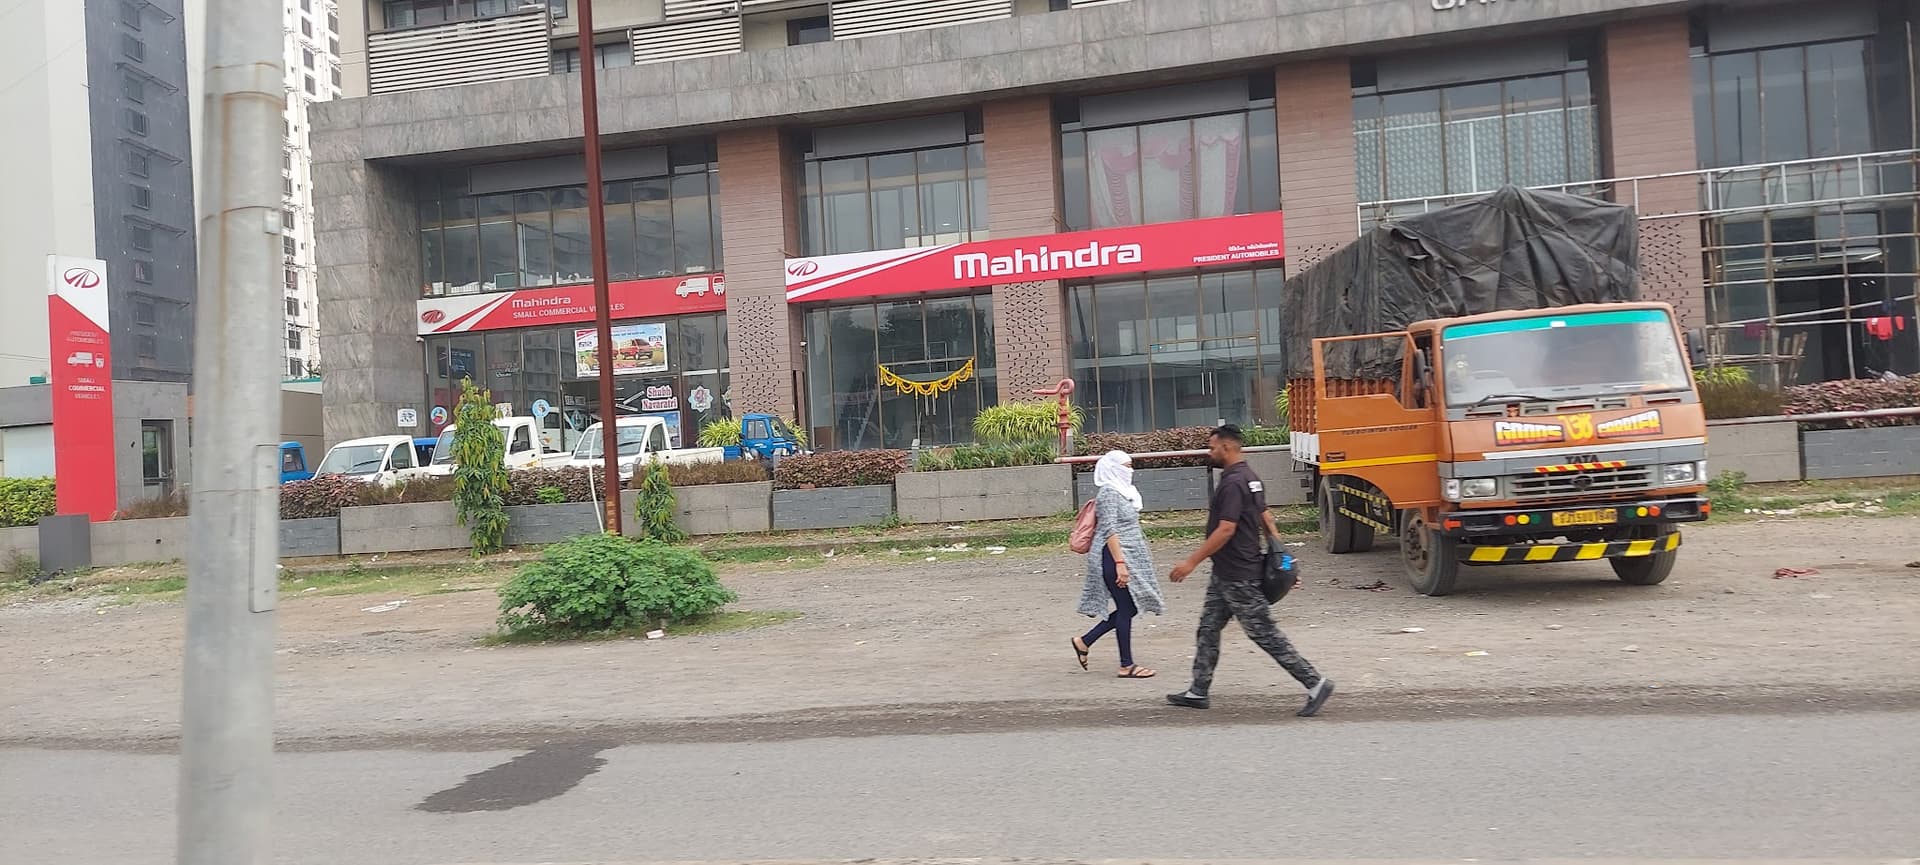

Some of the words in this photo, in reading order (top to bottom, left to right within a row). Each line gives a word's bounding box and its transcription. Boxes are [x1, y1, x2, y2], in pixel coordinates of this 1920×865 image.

[953, 241, 1143, 280] Mahindra
[1193, 253, 1230, 263] PRESIDENT
[1231, 249, 1280, 260] AUTOMOBILES
[511, 296, 572, 309] Mahindra
[512, 311, 537, 319] SMALL
[538, 305, 588, 317] COMMERCIAL
[647, 385, 672, 398] Shubh
[642, 397, 678, 410] Navaratri
[1495, 421, 1562, 445] GOODS
[1565, 454, 1599, 464] TATA
